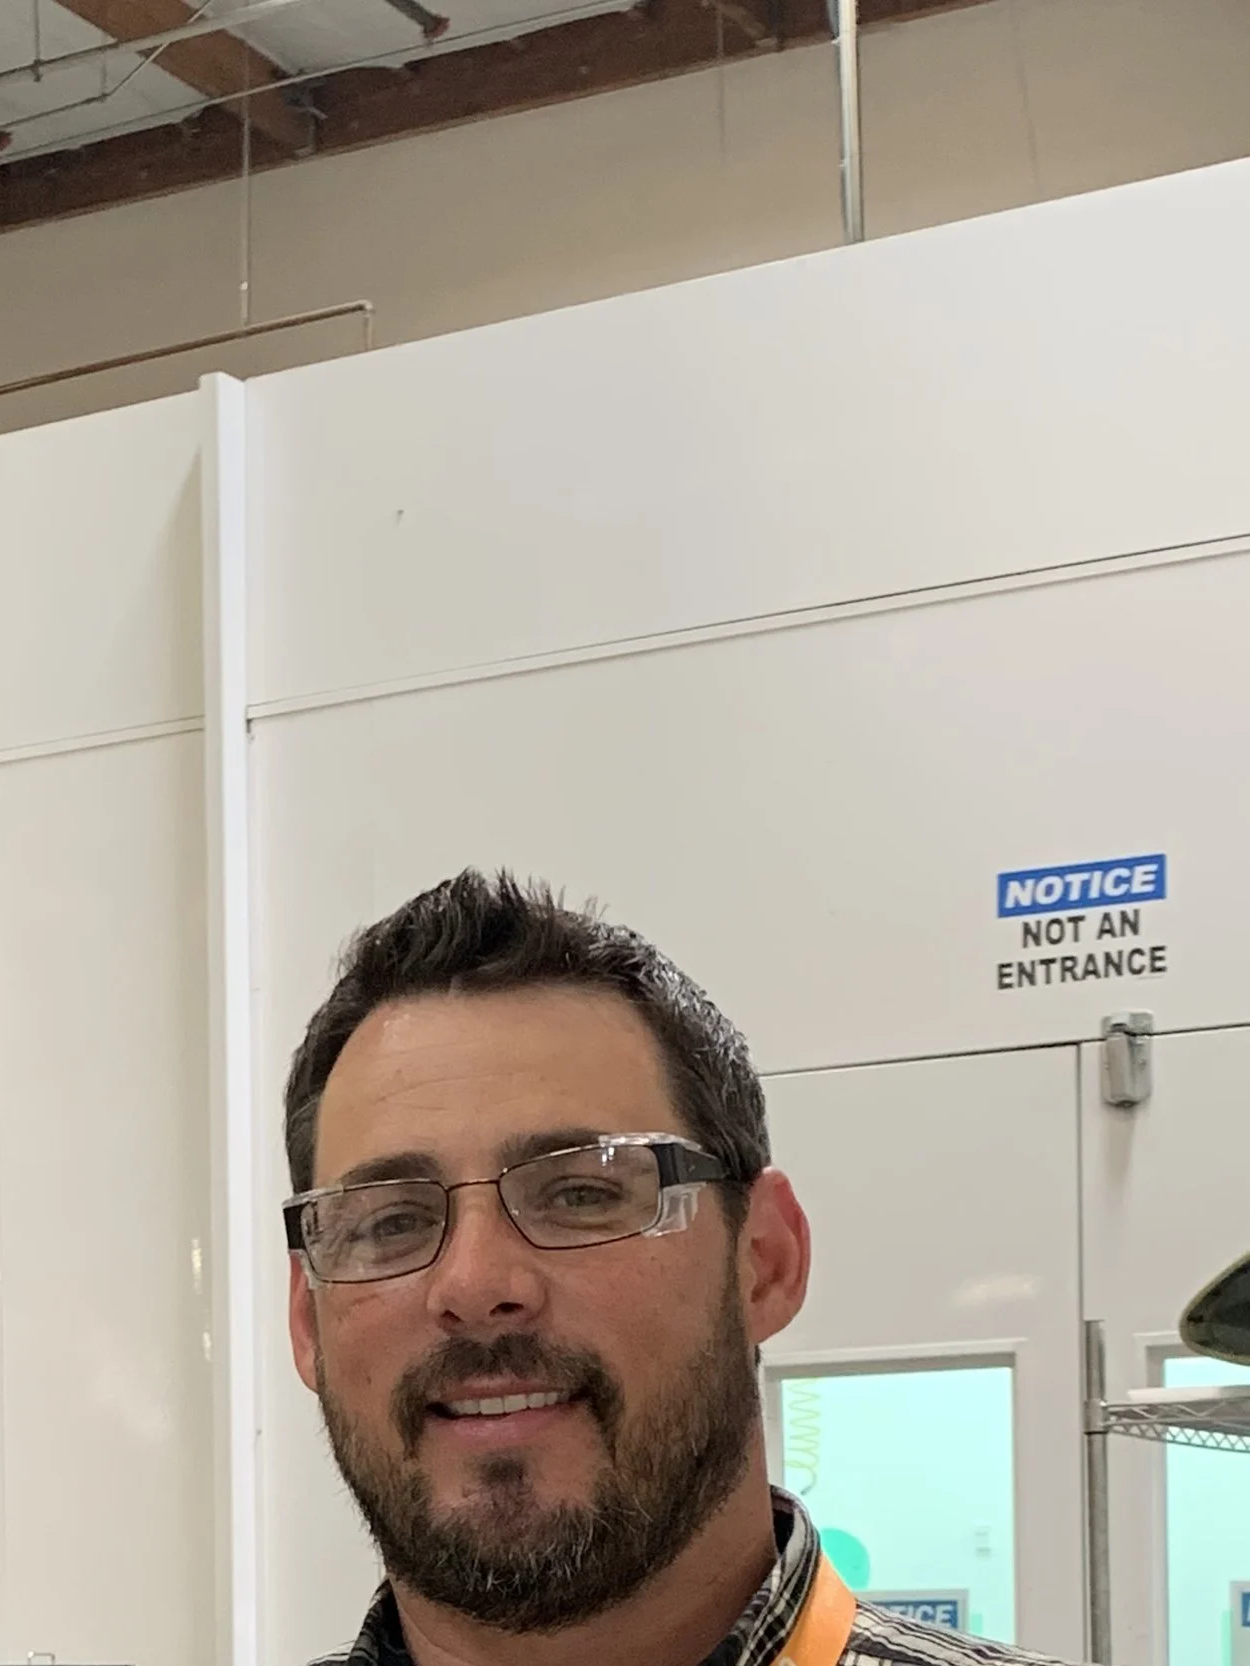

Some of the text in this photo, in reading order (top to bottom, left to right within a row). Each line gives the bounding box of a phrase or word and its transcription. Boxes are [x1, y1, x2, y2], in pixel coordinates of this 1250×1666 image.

[1003, 863, 1159, 909] NOTICE
[1022, 908, 1141, 949] NOT AN
[997, 945, 1167, 990] ENTRANCE
